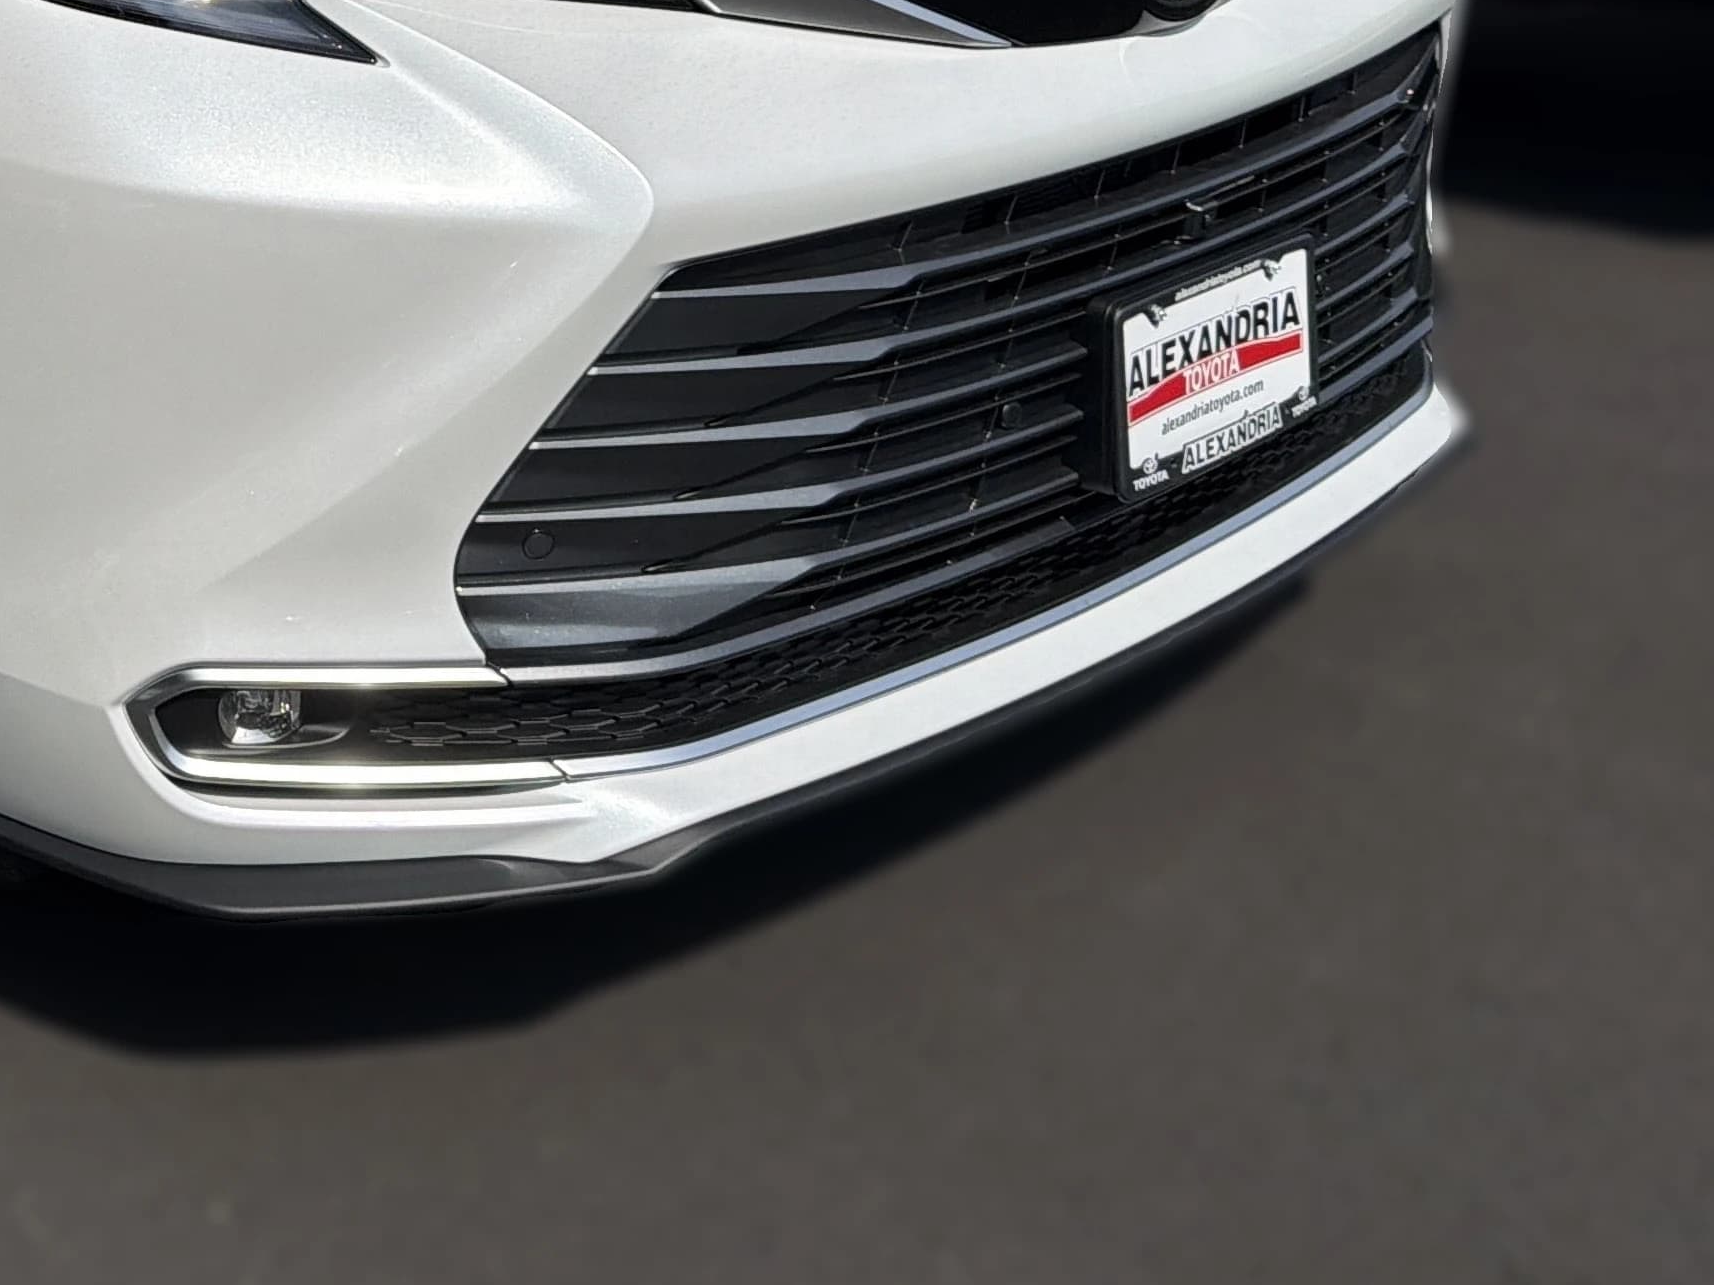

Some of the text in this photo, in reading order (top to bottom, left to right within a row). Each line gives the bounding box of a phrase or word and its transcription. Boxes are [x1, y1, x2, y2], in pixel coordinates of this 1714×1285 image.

[1128, 292, 1300, 396] ALEXANDRIA
[1184, 351, 1241, 394] TOYOTA
[1161, 379, 1265, 436] alexandriatoyota.com
[1183, 406, 1282, 470] ALEXANDRIA
[1133, 468, 1170, 492] TOYOTA
